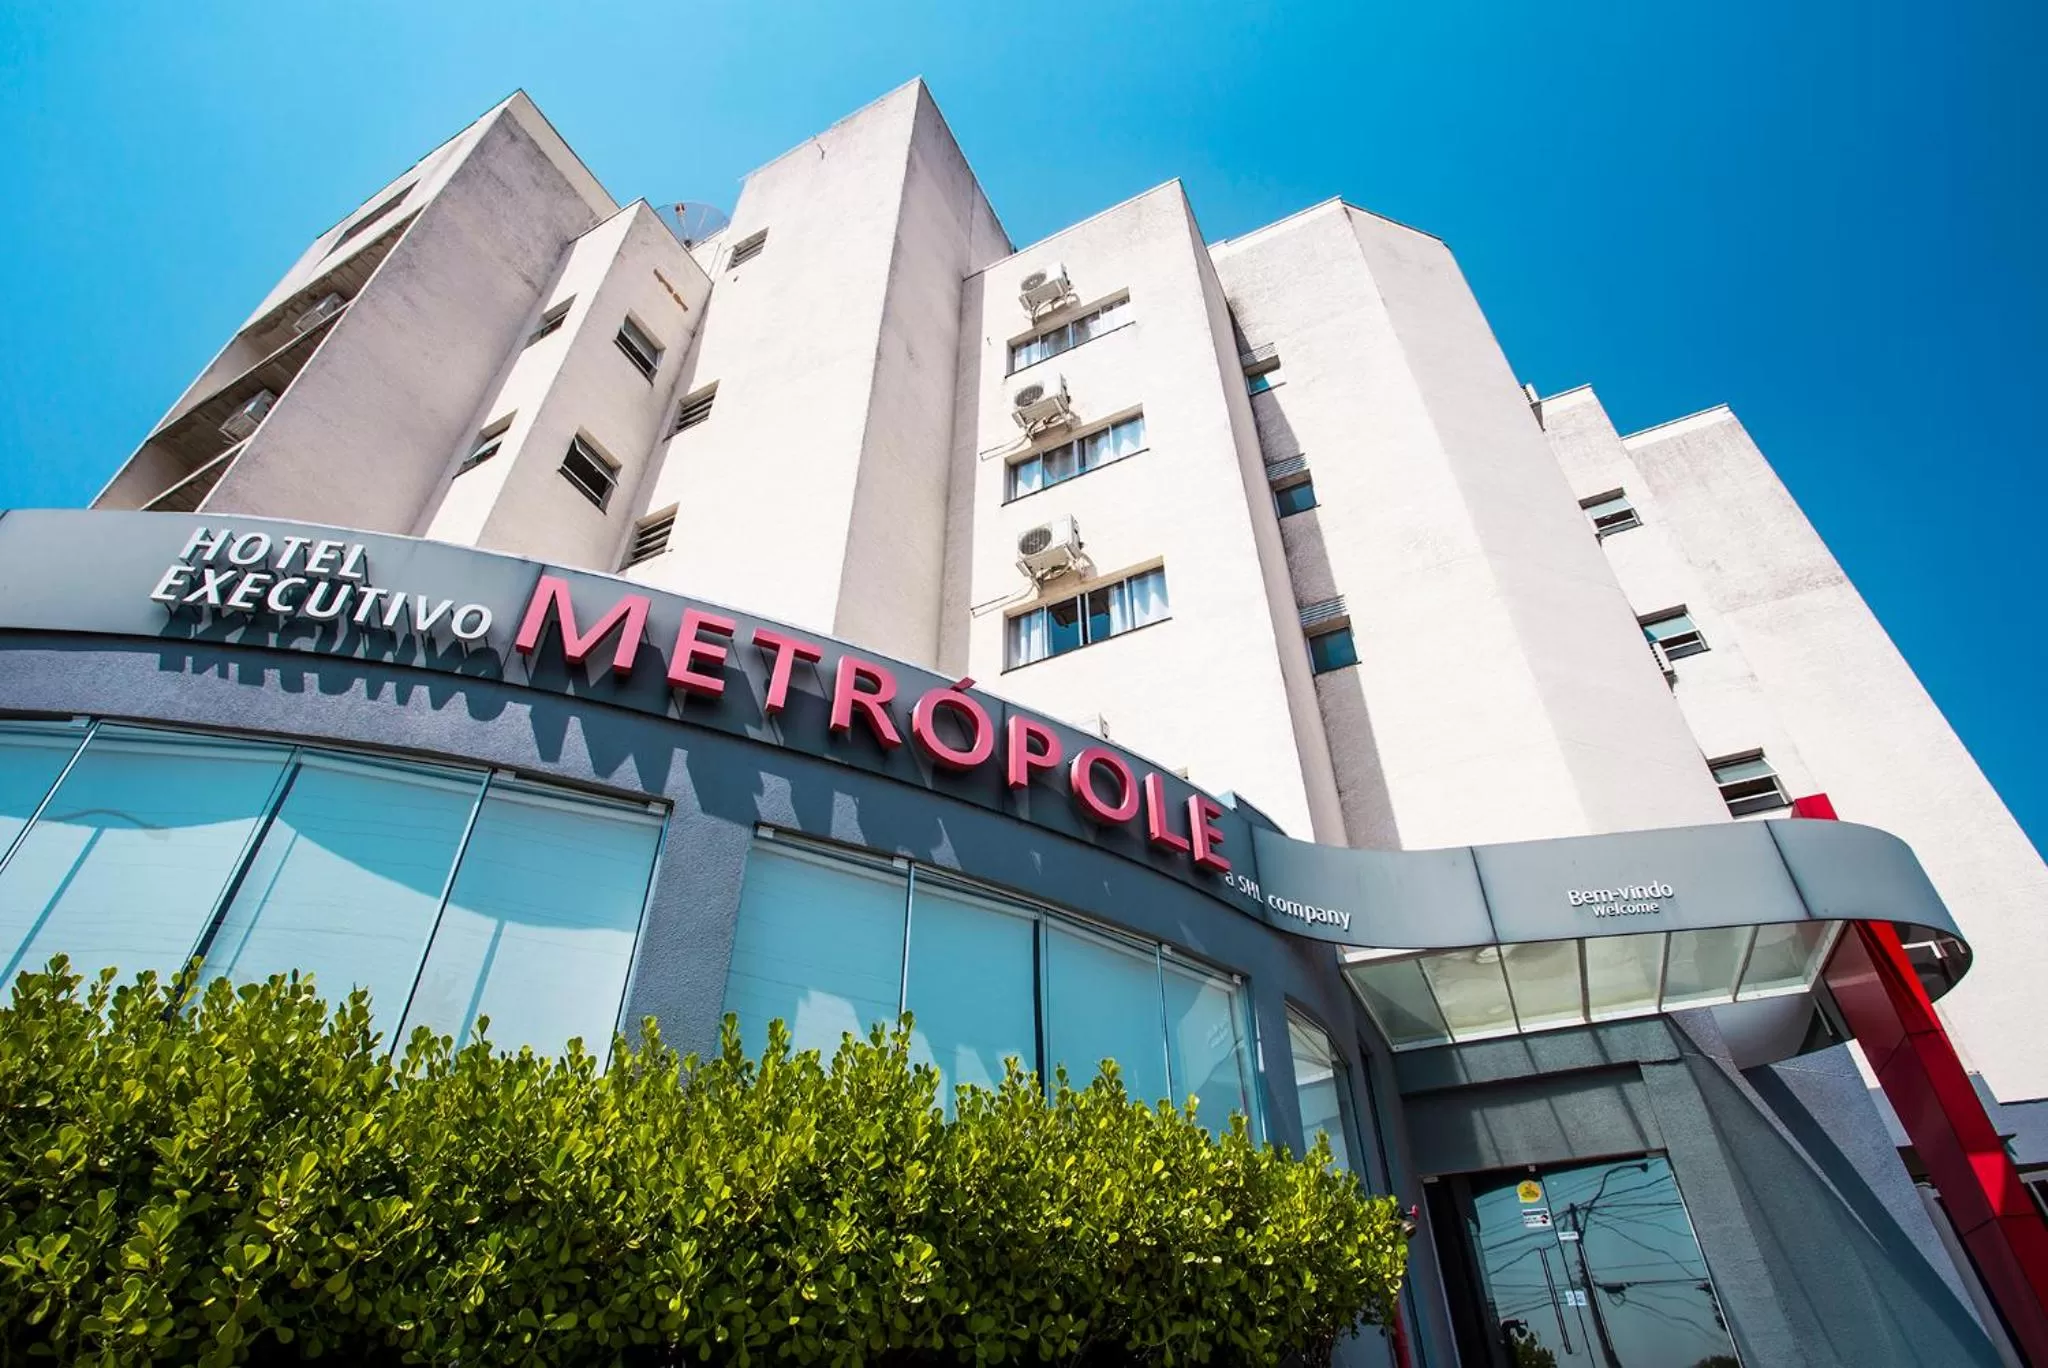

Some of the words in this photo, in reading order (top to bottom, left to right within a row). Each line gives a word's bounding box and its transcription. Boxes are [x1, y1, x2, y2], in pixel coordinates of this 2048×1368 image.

[178, 527, 368, 581] HOTEL
[149, 564, 493, 641] EXECUTIVO
[515, 574, 1231, 873] METRÓPOLE
[1225, 871, 1235, 887] a
[1238, 874, 1264, 903] SHL
[1268, 894, 1351, 931] company
[1568, 880, 1674, 906] Bem-vindo
[1592, 901, 1660, 917] Welcome
